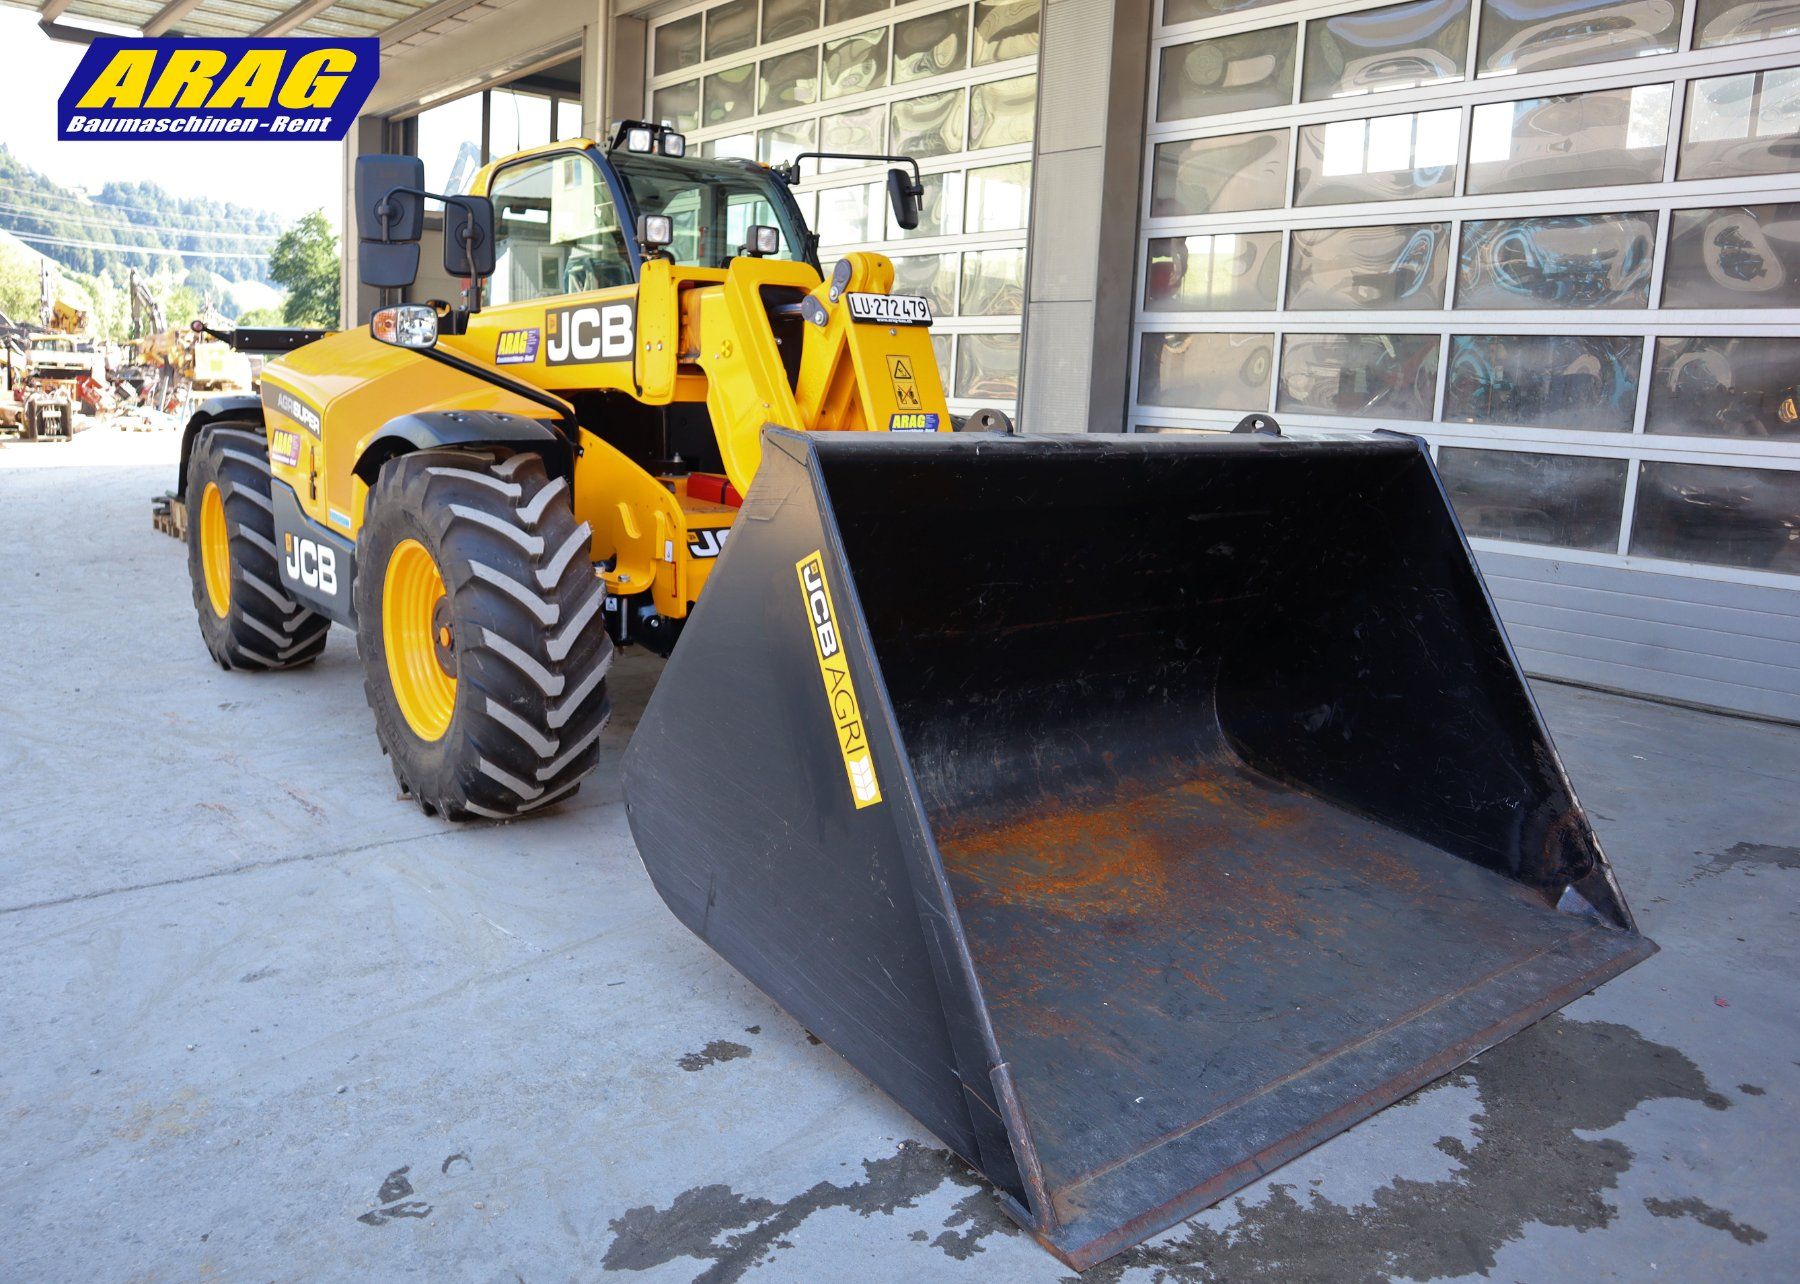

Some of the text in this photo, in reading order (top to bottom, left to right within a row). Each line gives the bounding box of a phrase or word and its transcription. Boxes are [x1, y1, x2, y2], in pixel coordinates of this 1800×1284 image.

[498, 331, 528, 355] ARAG
[547, 304, 634, 362] JCB
[892, 414, 926, 429] ARAG
[286, 535, 338, 596] JCB
[803, 565, 865, 755] JCB AGRI
